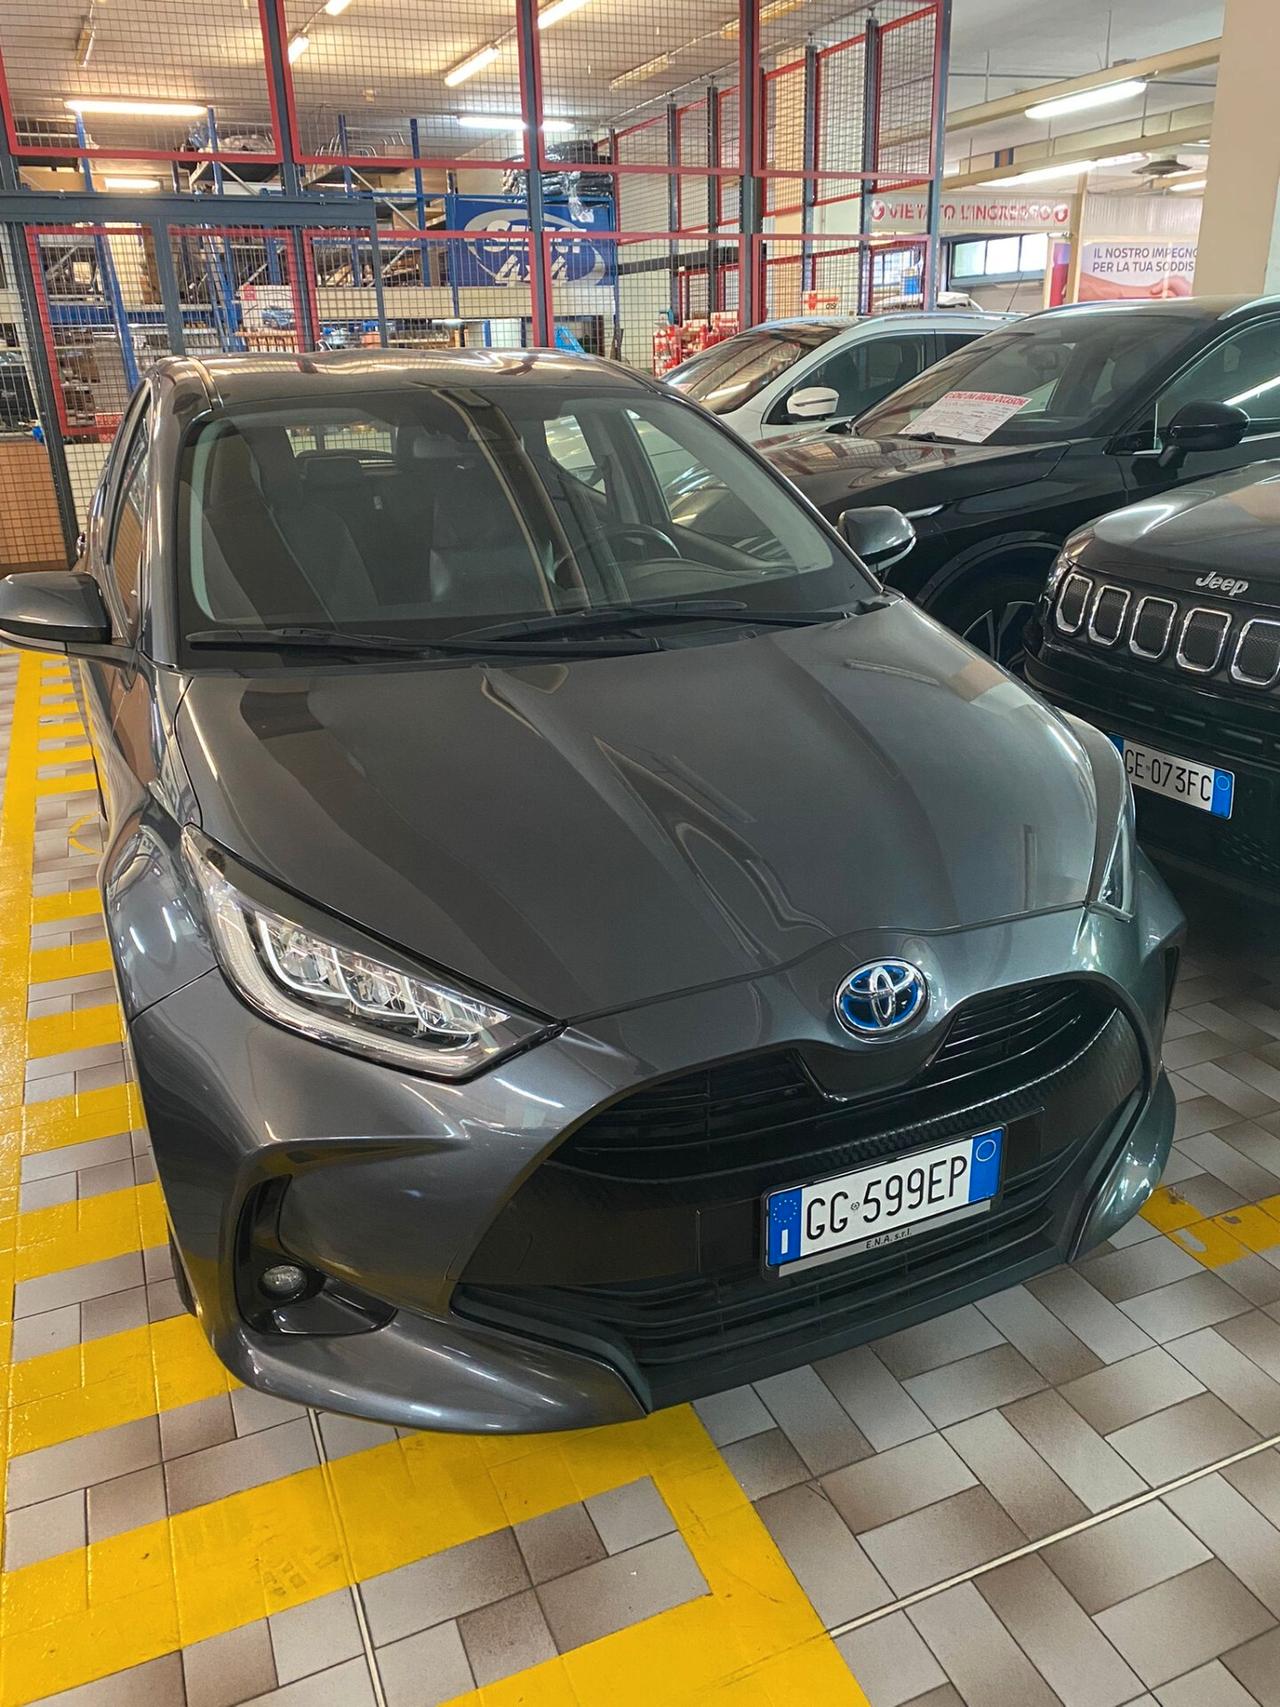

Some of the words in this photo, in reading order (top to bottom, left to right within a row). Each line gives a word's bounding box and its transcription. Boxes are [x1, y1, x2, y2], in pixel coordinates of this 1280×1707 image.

[889, 202, 956, 221] VIETO
[1093, 248, 1103, 259] IL
[1105, 248, 1150, 259] NOSTRO
[1092, 262, 1114, 272] PER
[1116, 262, 1130, 272] LA
[1132, 262, 1153, 272] TUA
[1195, 571, 1249, 596] Jeep
[780, 1228, 789, 1255] I
[866, 1235, 893, 1249] E.N.A.
[894, 1228, 912, 1240] s.r.l.
